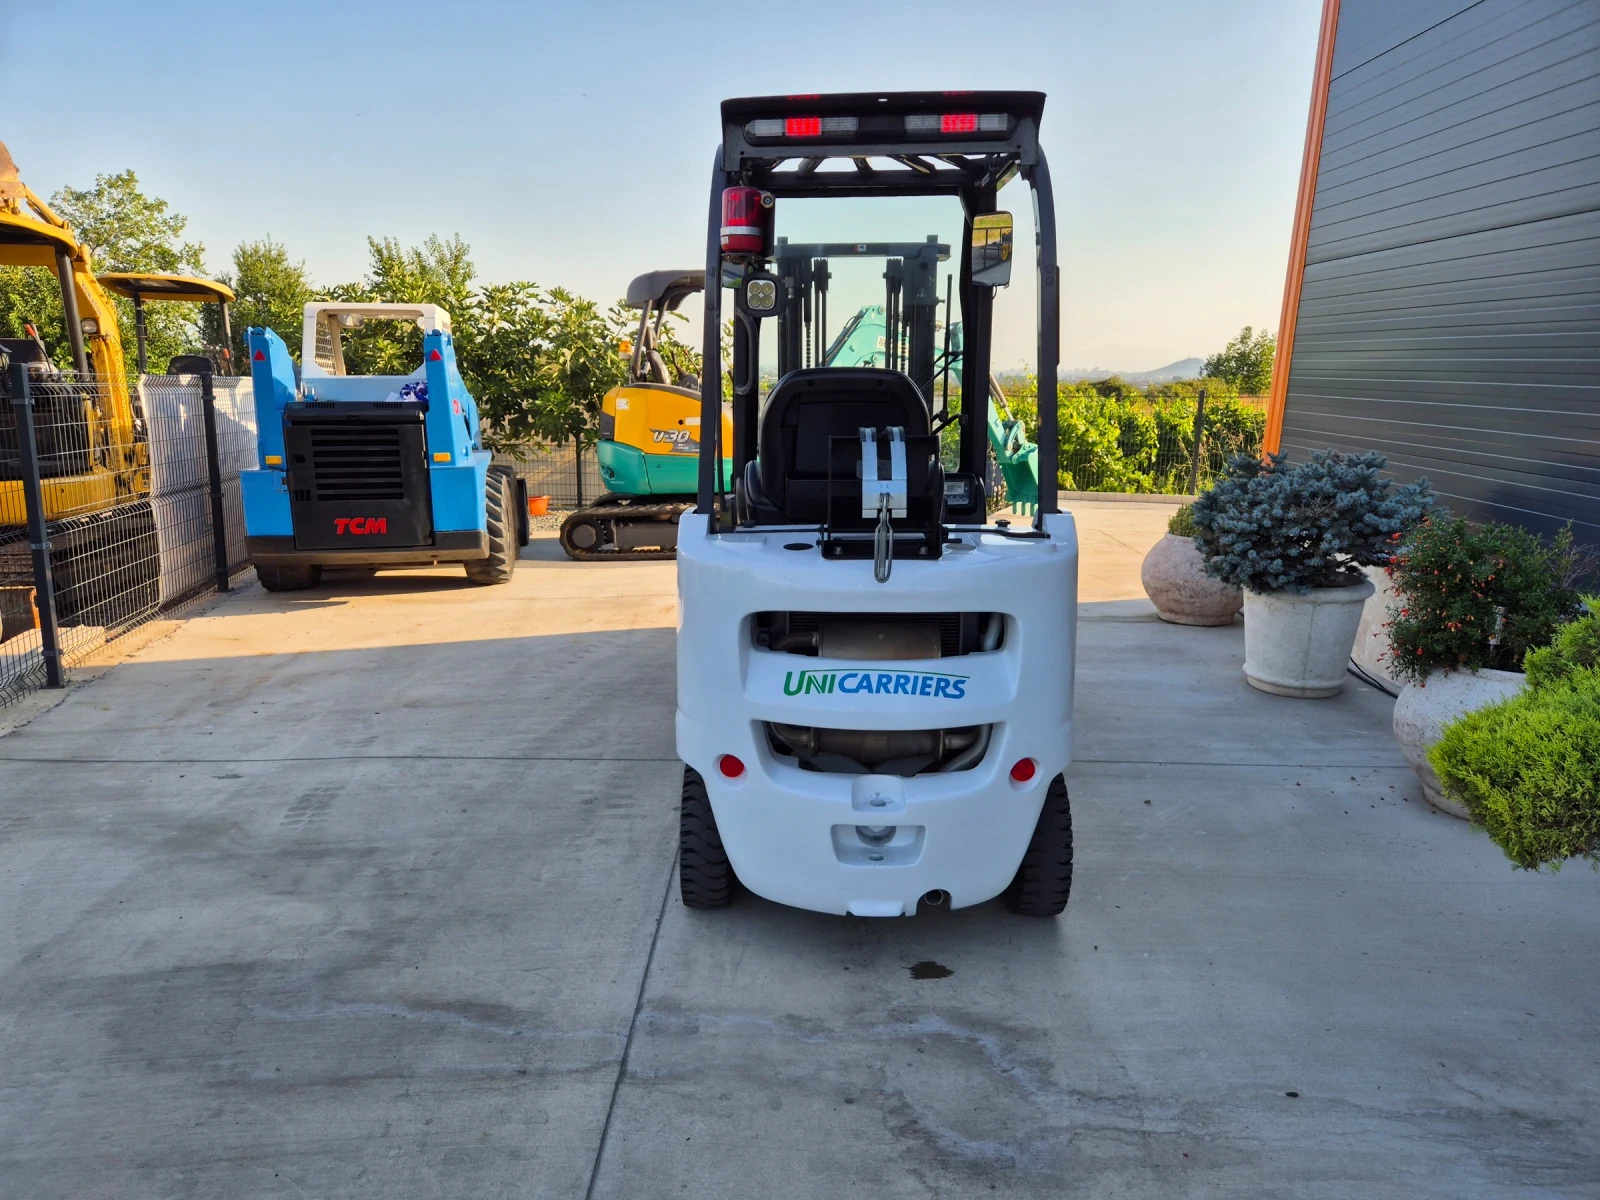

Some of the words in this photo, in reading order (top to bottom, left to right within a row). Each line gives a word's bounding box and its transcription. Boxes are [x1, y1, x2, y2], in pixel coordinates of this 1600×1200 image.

[653, 429, 690, 443] U-30
[334, 517, 387, 535] TCM
[783, 669, 968, 699] UNICARRIERS
